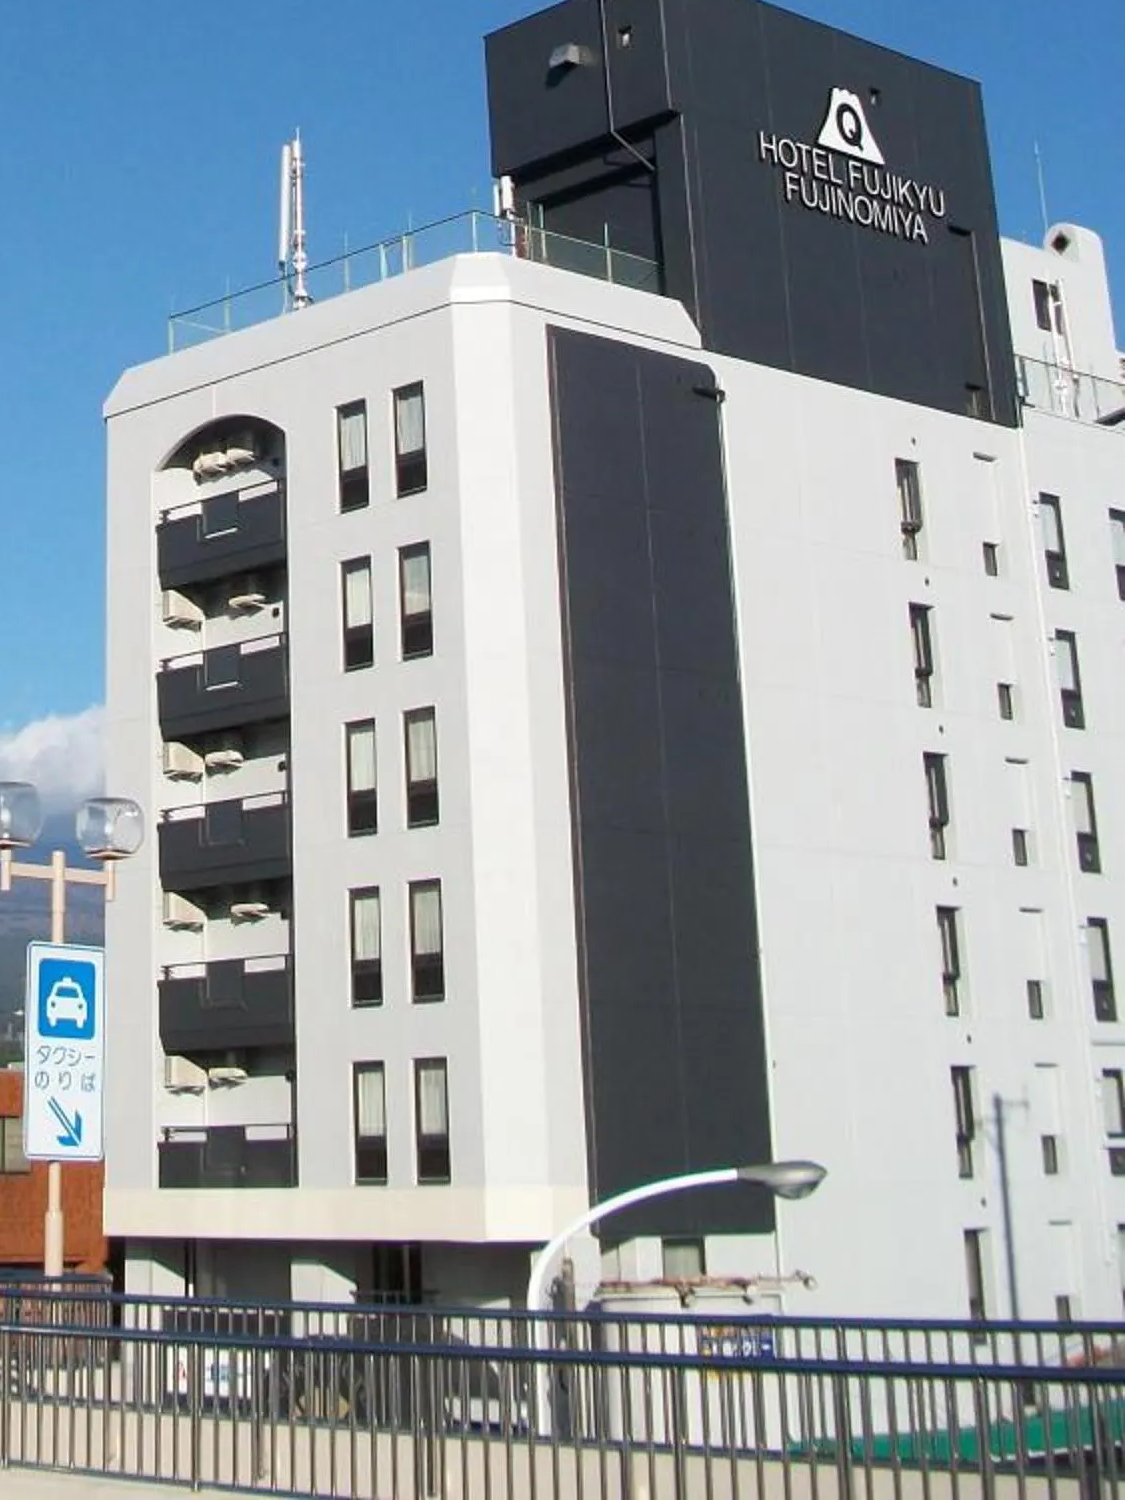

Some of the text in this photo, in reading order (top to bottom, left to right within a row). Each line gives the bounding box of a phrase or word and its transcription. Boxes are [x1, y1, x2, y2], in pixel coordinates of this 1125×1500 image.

[759, 131, 945, 217] HOTEL FUJIKYU
[785, 171, 928, 245] FUJINOMIYA
[36, 1045, 96, 1067] タクシー
[34, 1070, 97, 1093] のりば
